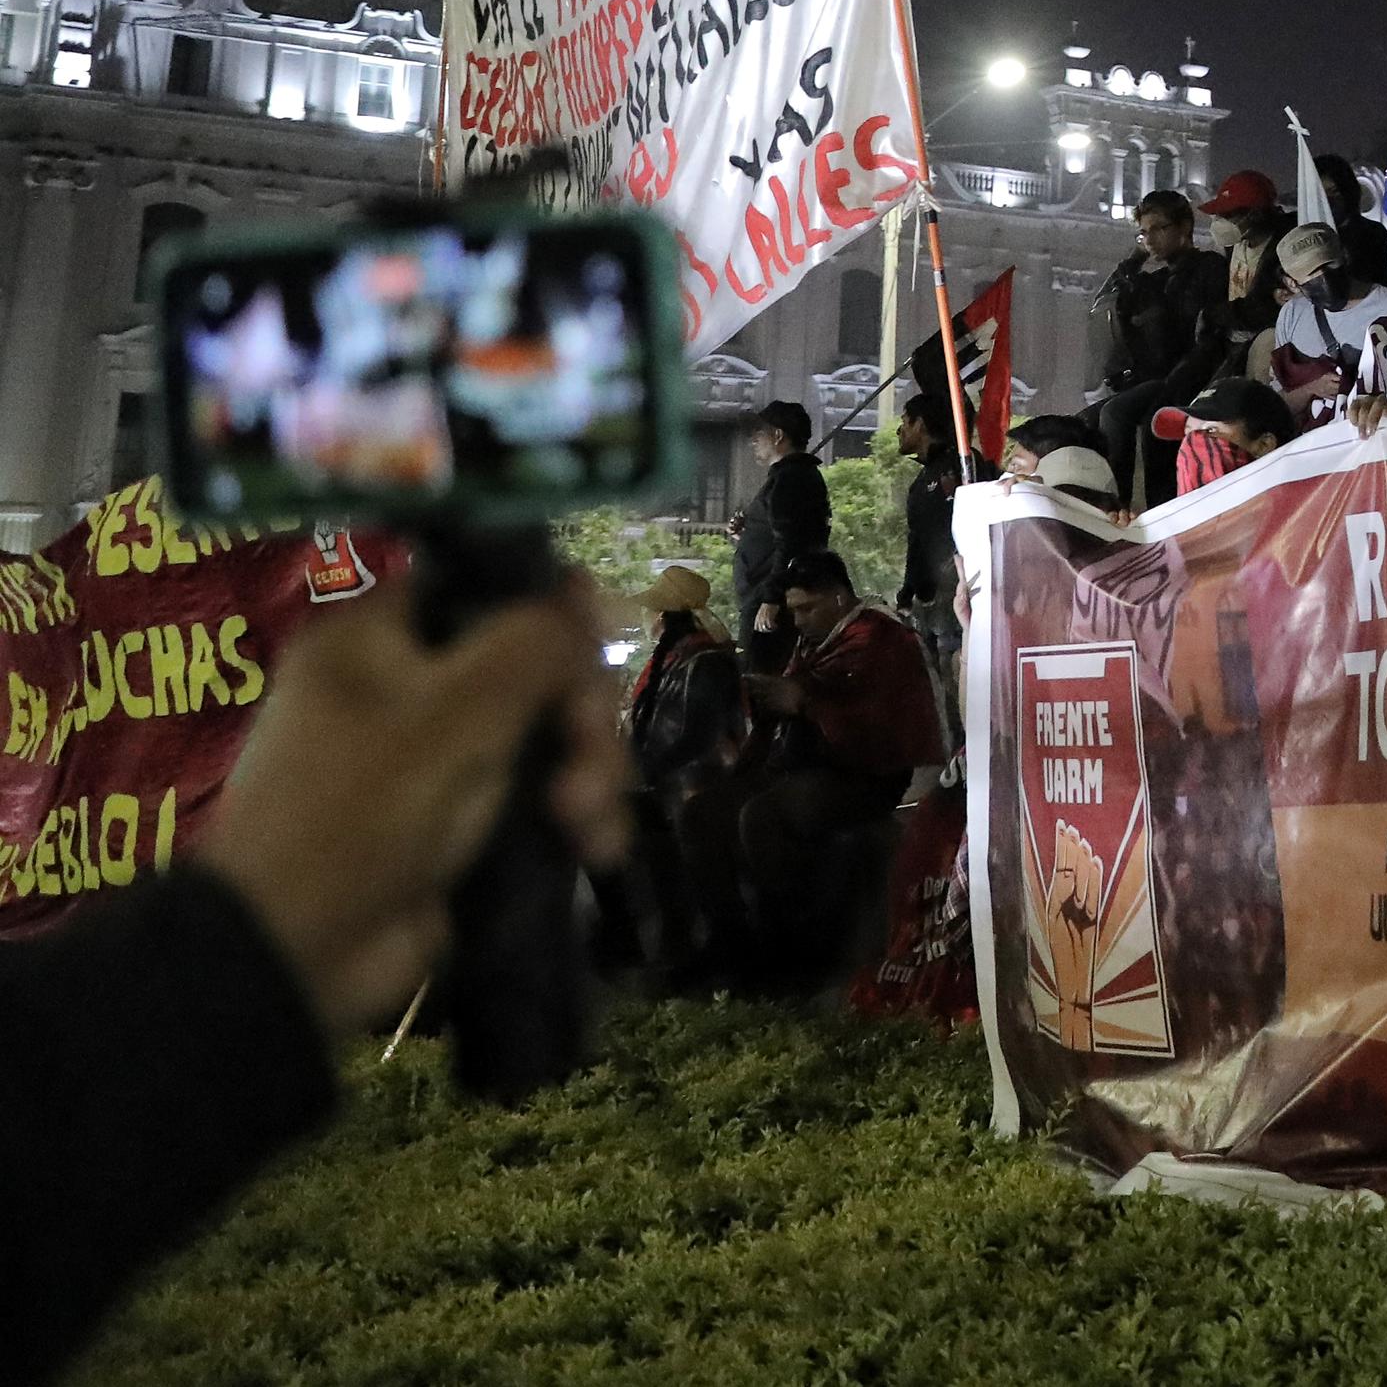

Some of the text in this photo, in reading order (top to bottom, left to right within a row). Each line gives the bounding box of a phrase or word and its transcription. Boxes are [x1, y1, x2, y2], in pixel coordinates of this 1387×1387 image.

[725, 113, 920, 305] CALLES
[1035, 698, 1113, 749] FRENTE
[1043, 756, 1104, 806] UARM
